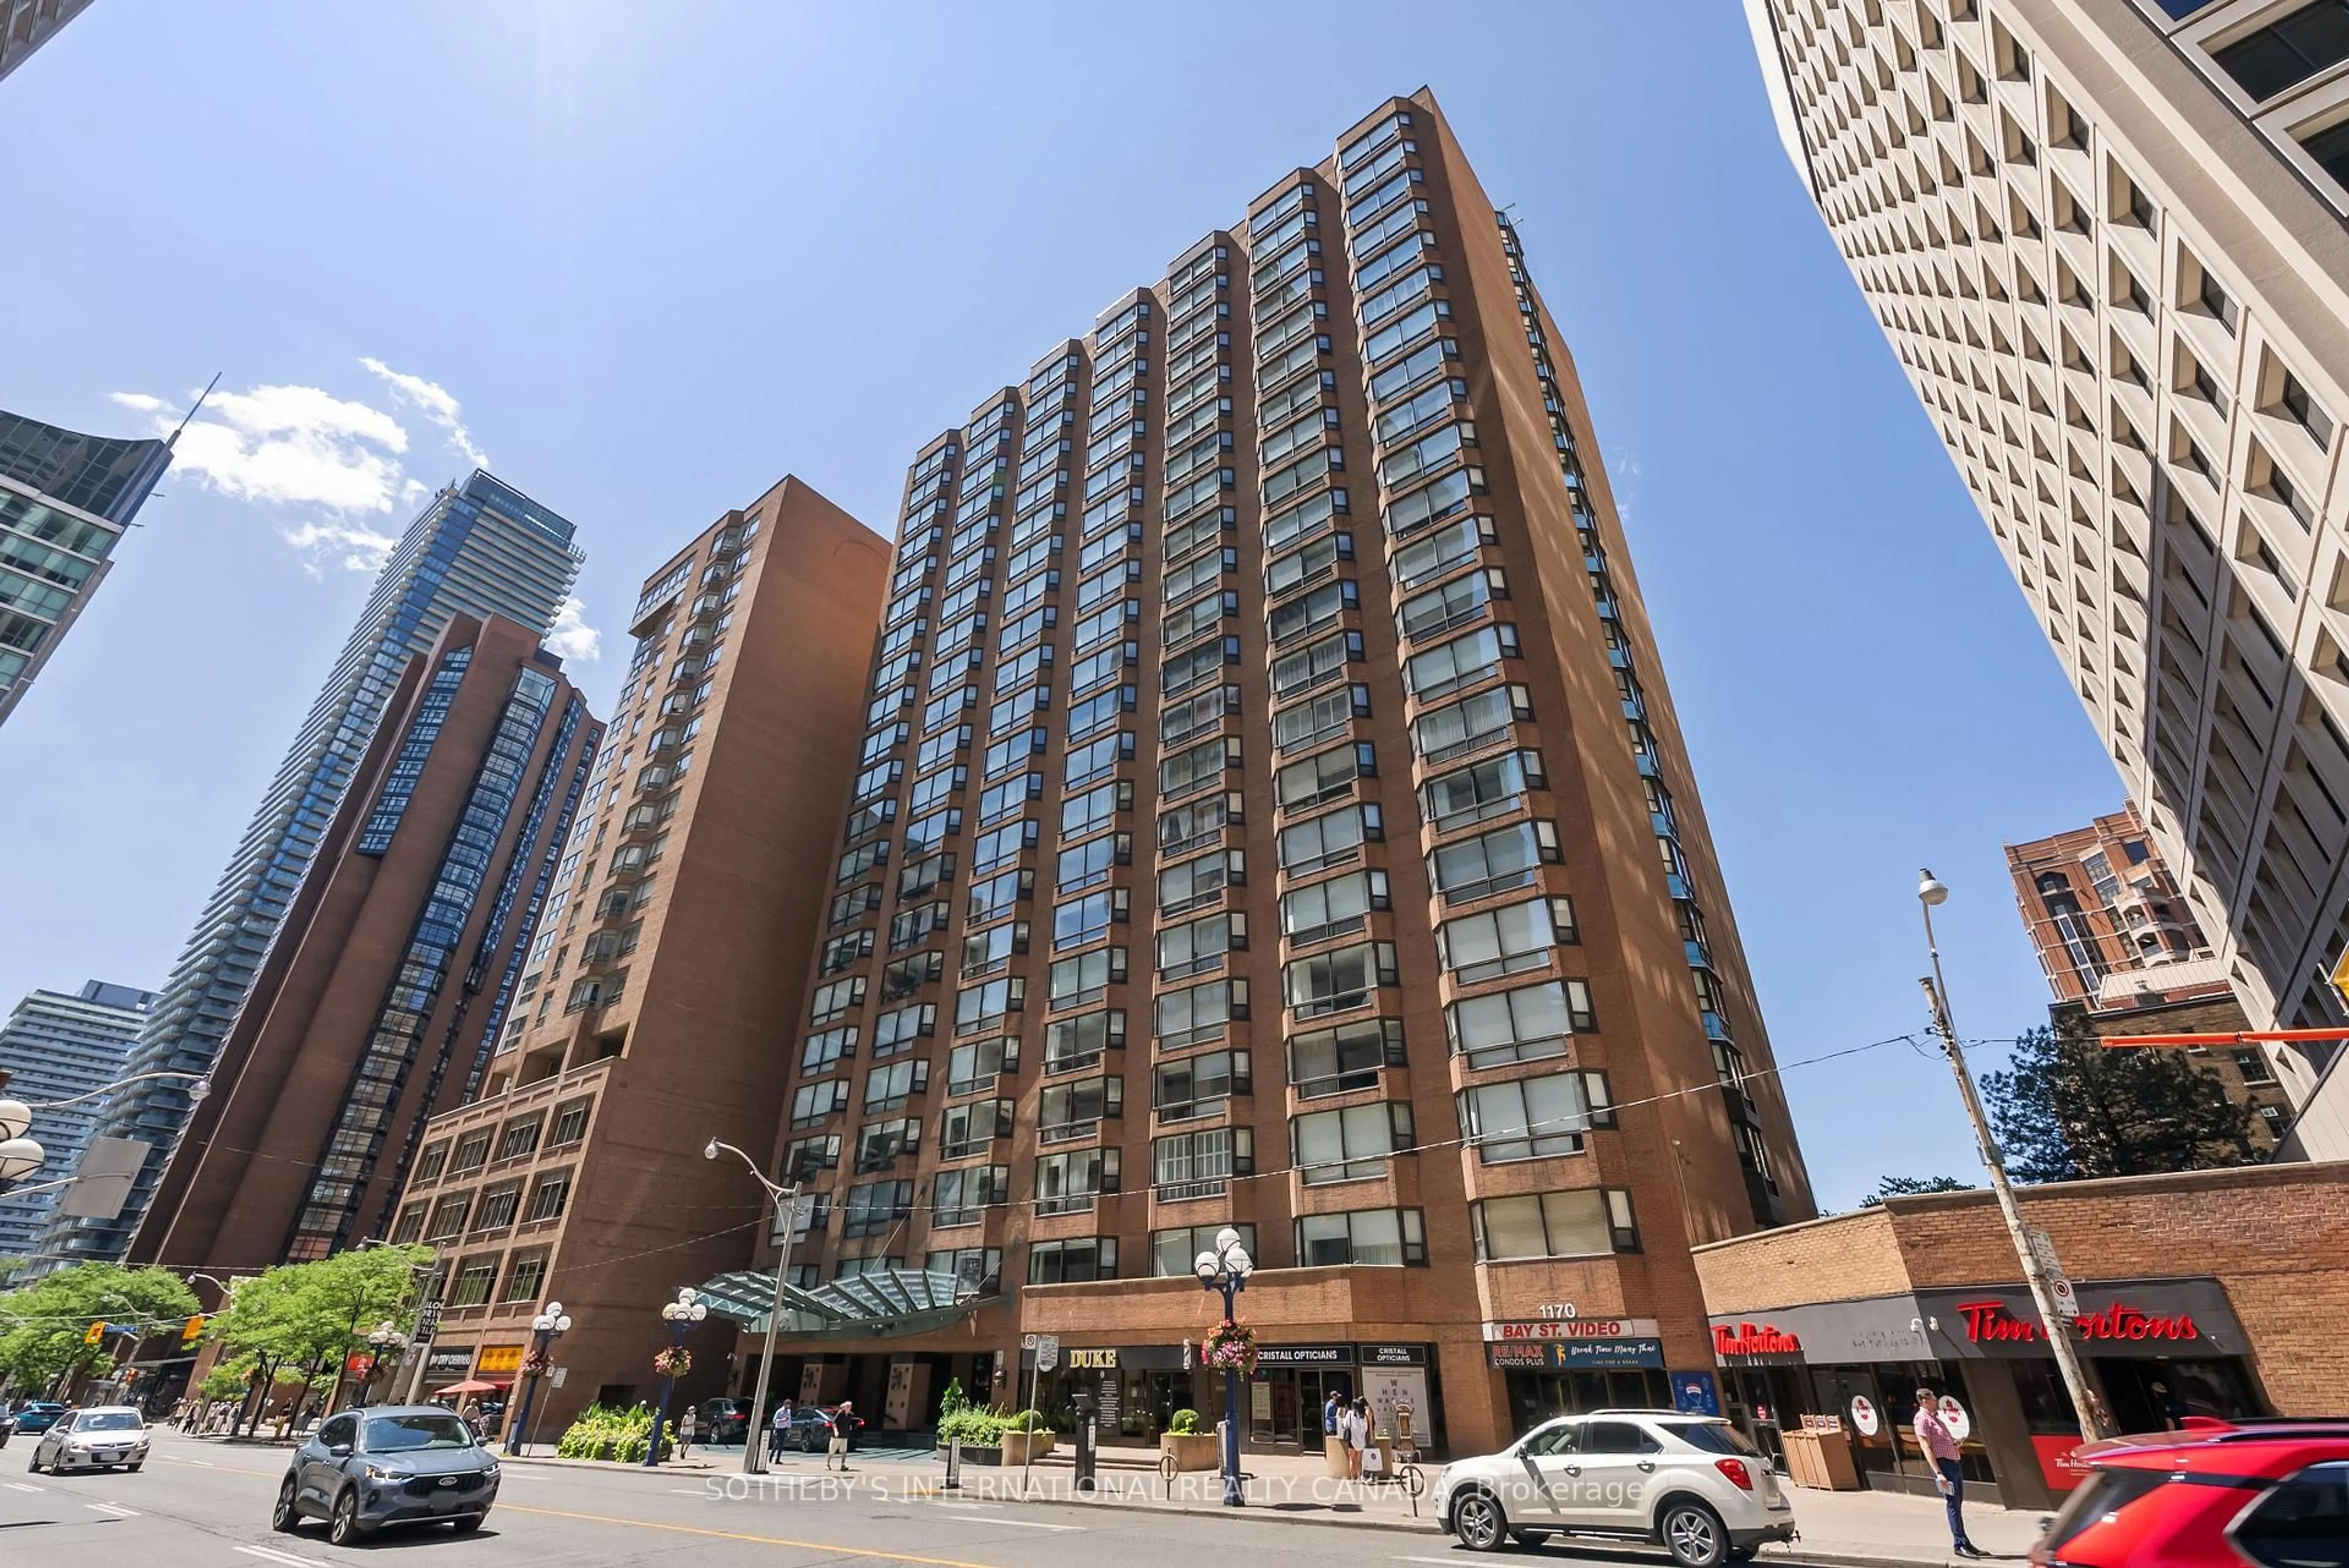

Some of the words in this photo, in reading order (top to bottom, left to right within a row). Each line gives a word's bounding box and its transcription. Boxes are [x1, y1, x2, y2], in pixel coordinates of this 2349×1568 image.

[1538, 1303, 1576, 1319] 1170
[1503, 1324, 1534, 1337] BAY
[1538, 1323, 1562, 1337] ST.
[1567, 1322, 1621, 1336] VIDEO
[1958, 1300, 2034, 1343] Tim
[2038, 1301, 2197, 1341] ortons
[1709, 1325, 1741, 1355] Tim
[1740, 1321, 1798, 1354] Hortons
[1069, 1350, 1116, 1368] DUKE
[1257, 1351, 1293, 1360] CRISTALL
[1294, 1350, 1338, 1360] OPTICIANS
[1493, 1345, 1544, 1357] RE/MAX
